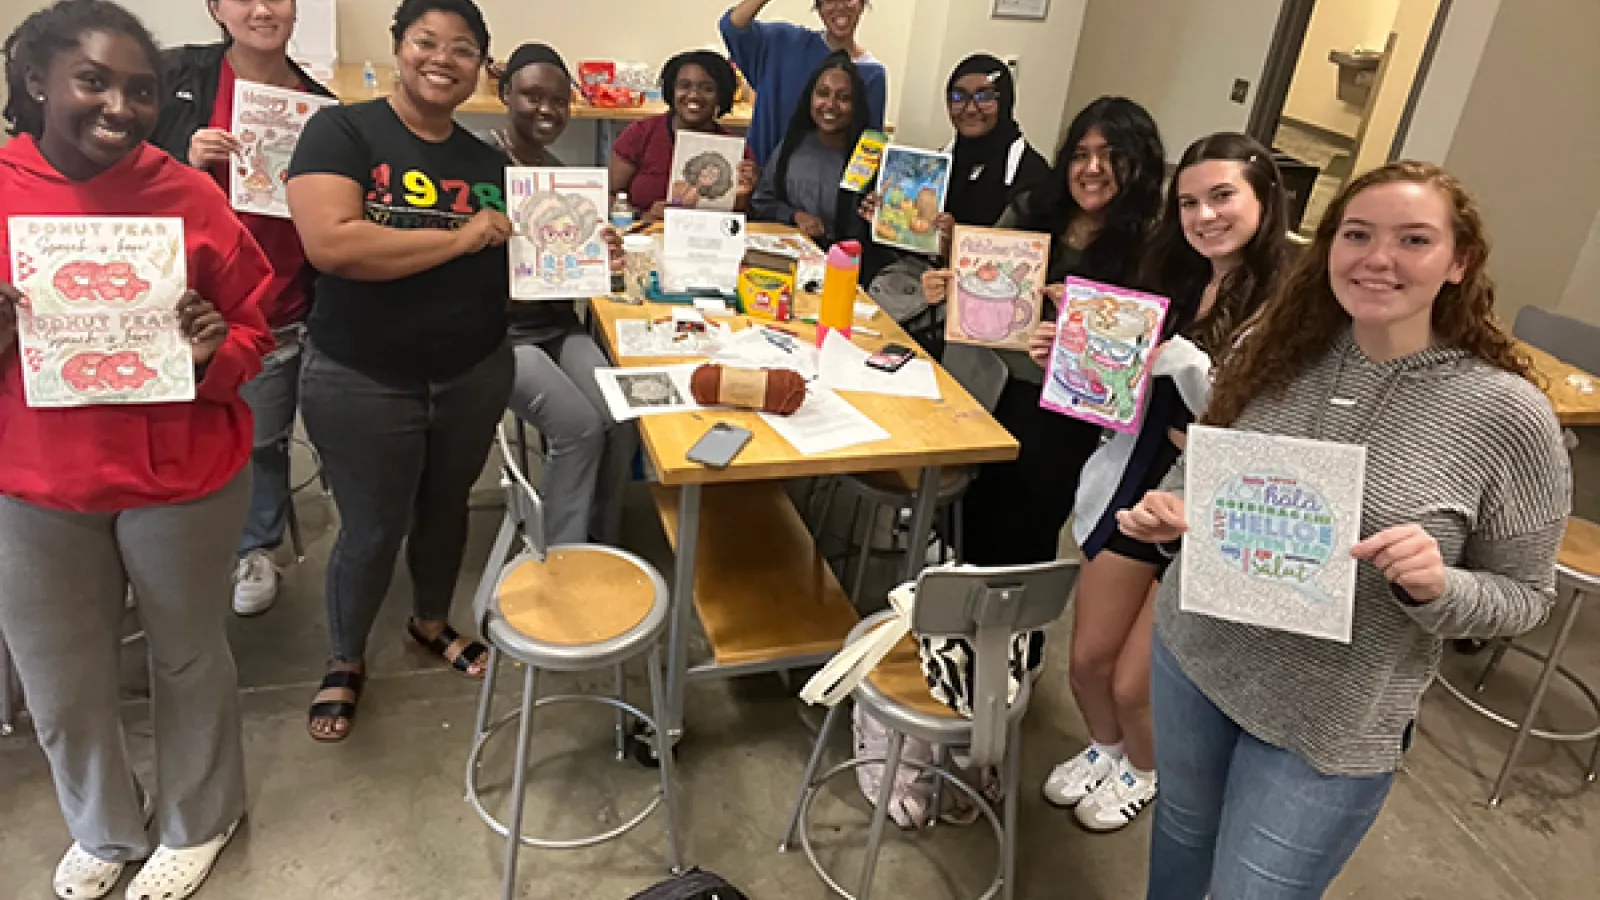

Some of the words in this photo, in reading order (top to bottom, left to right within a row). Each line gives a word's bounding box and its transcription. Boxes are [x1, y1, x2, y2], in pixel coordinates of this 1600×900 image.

[367, 163, 507, 214] 1978
[28, 222, 101, 236] DONUT
[35, 314, 110, 331] DONUT
[1264, 485, 1322, 512] hola
[1228, 511, 1317, 543] HELLO
[1251, 554, 1307, 583] salut
